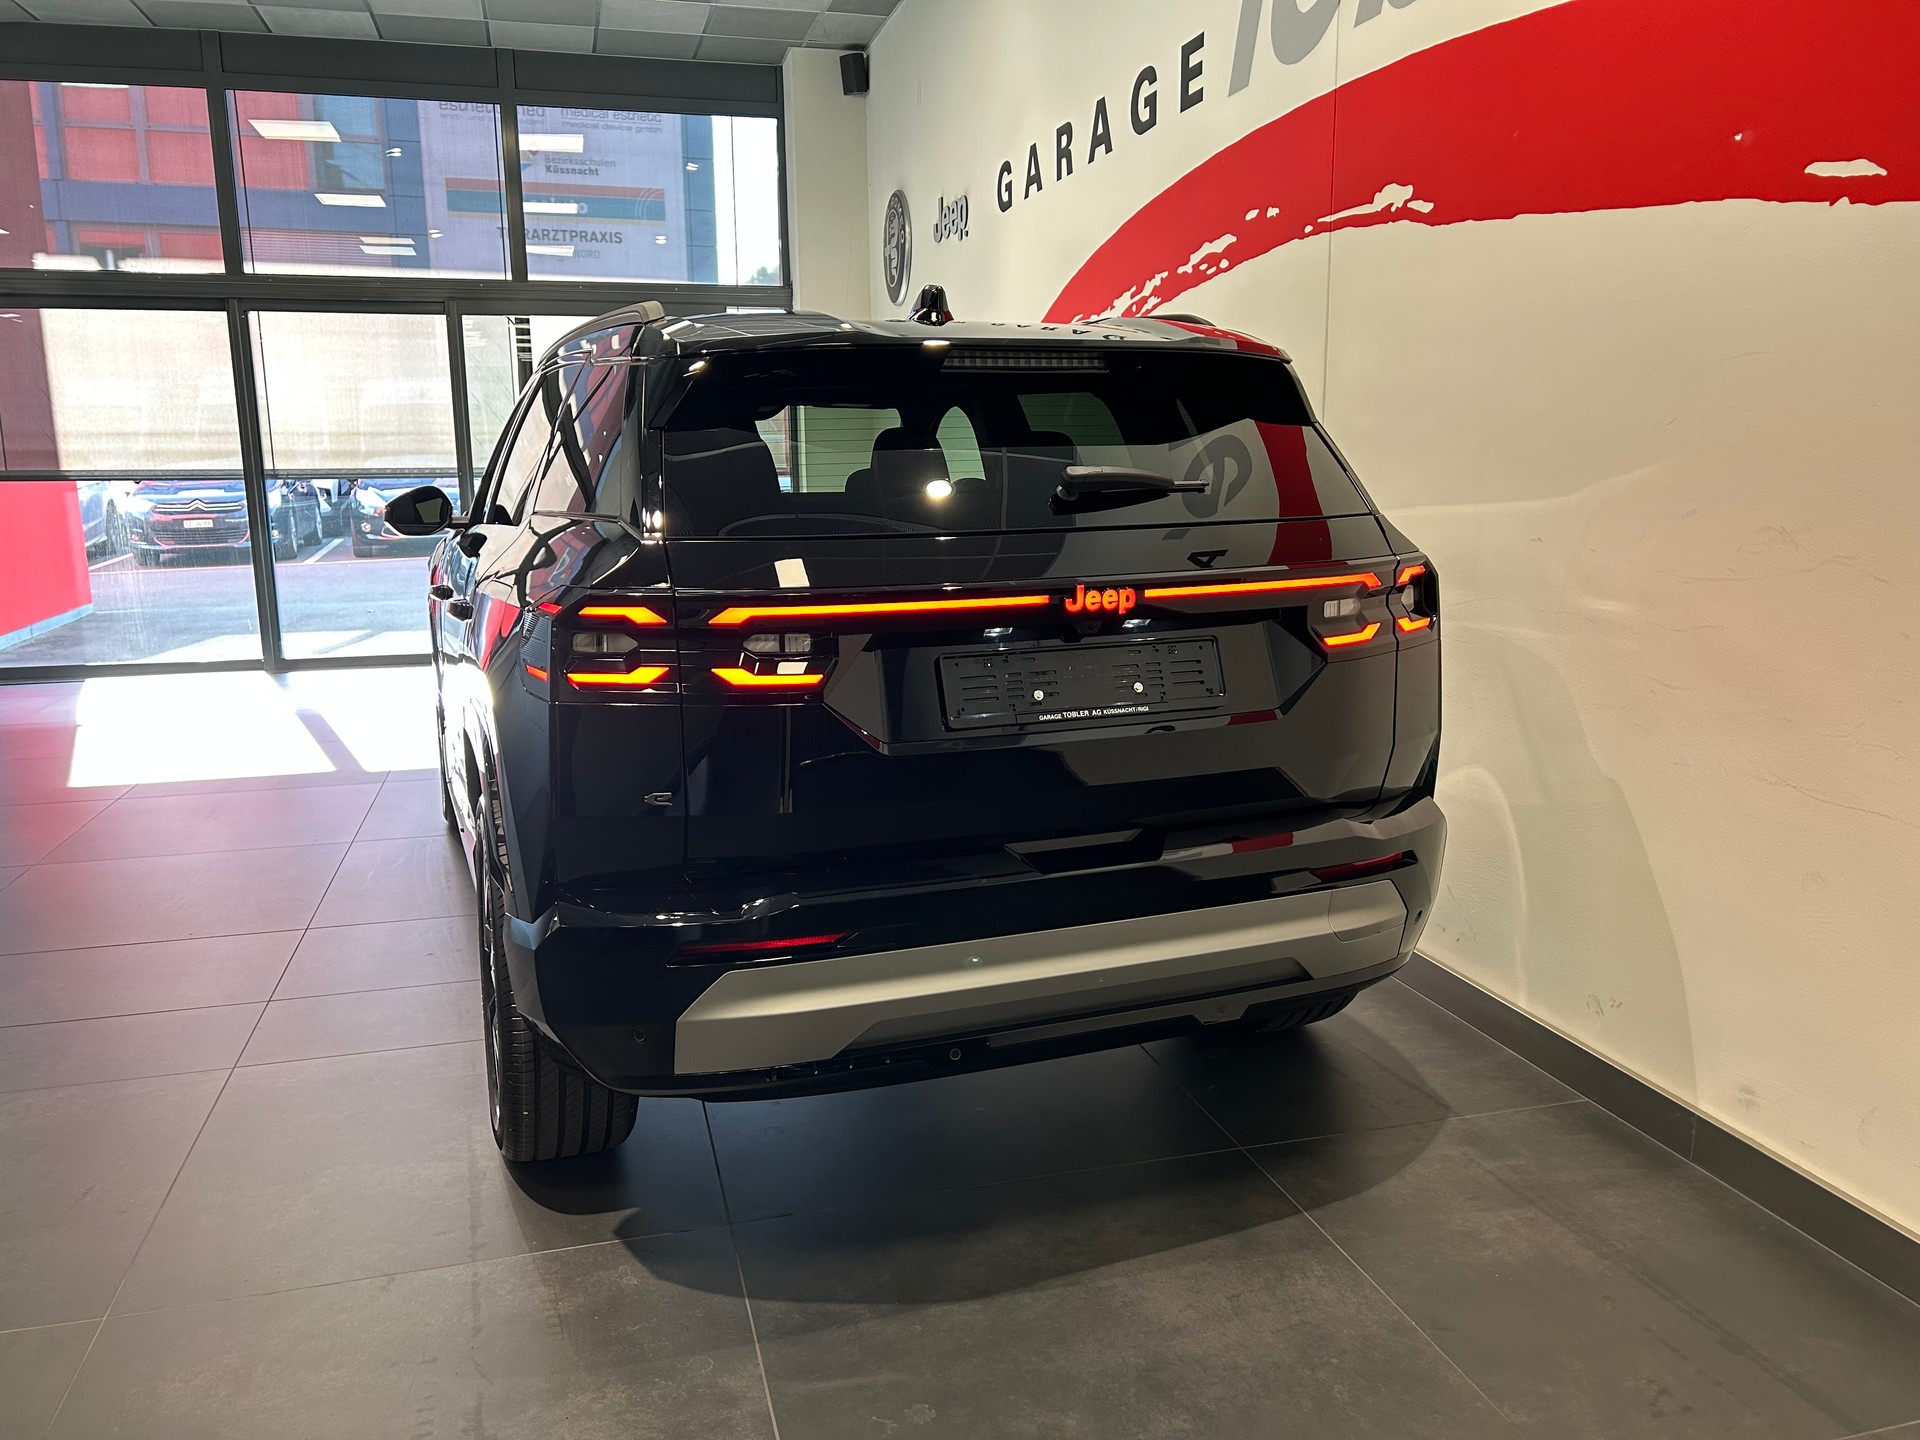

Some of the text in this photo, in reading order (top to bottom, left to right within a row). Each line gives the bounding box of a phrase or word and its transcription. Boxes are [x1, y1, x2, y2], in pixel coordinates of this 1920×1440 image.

[997, 31, 1205, 213] GARAGE
[544, 155, 616, 168] Bezirksschulen
[545, 165, 600, 176] Küssnacht
[933, 195, 969, 243] Jeep
[1065, 585, 1136, 614] Jeep
[1039, 713, 1062, 721] GARAGE
[1062, 710, 1090, 719] TOBLER
